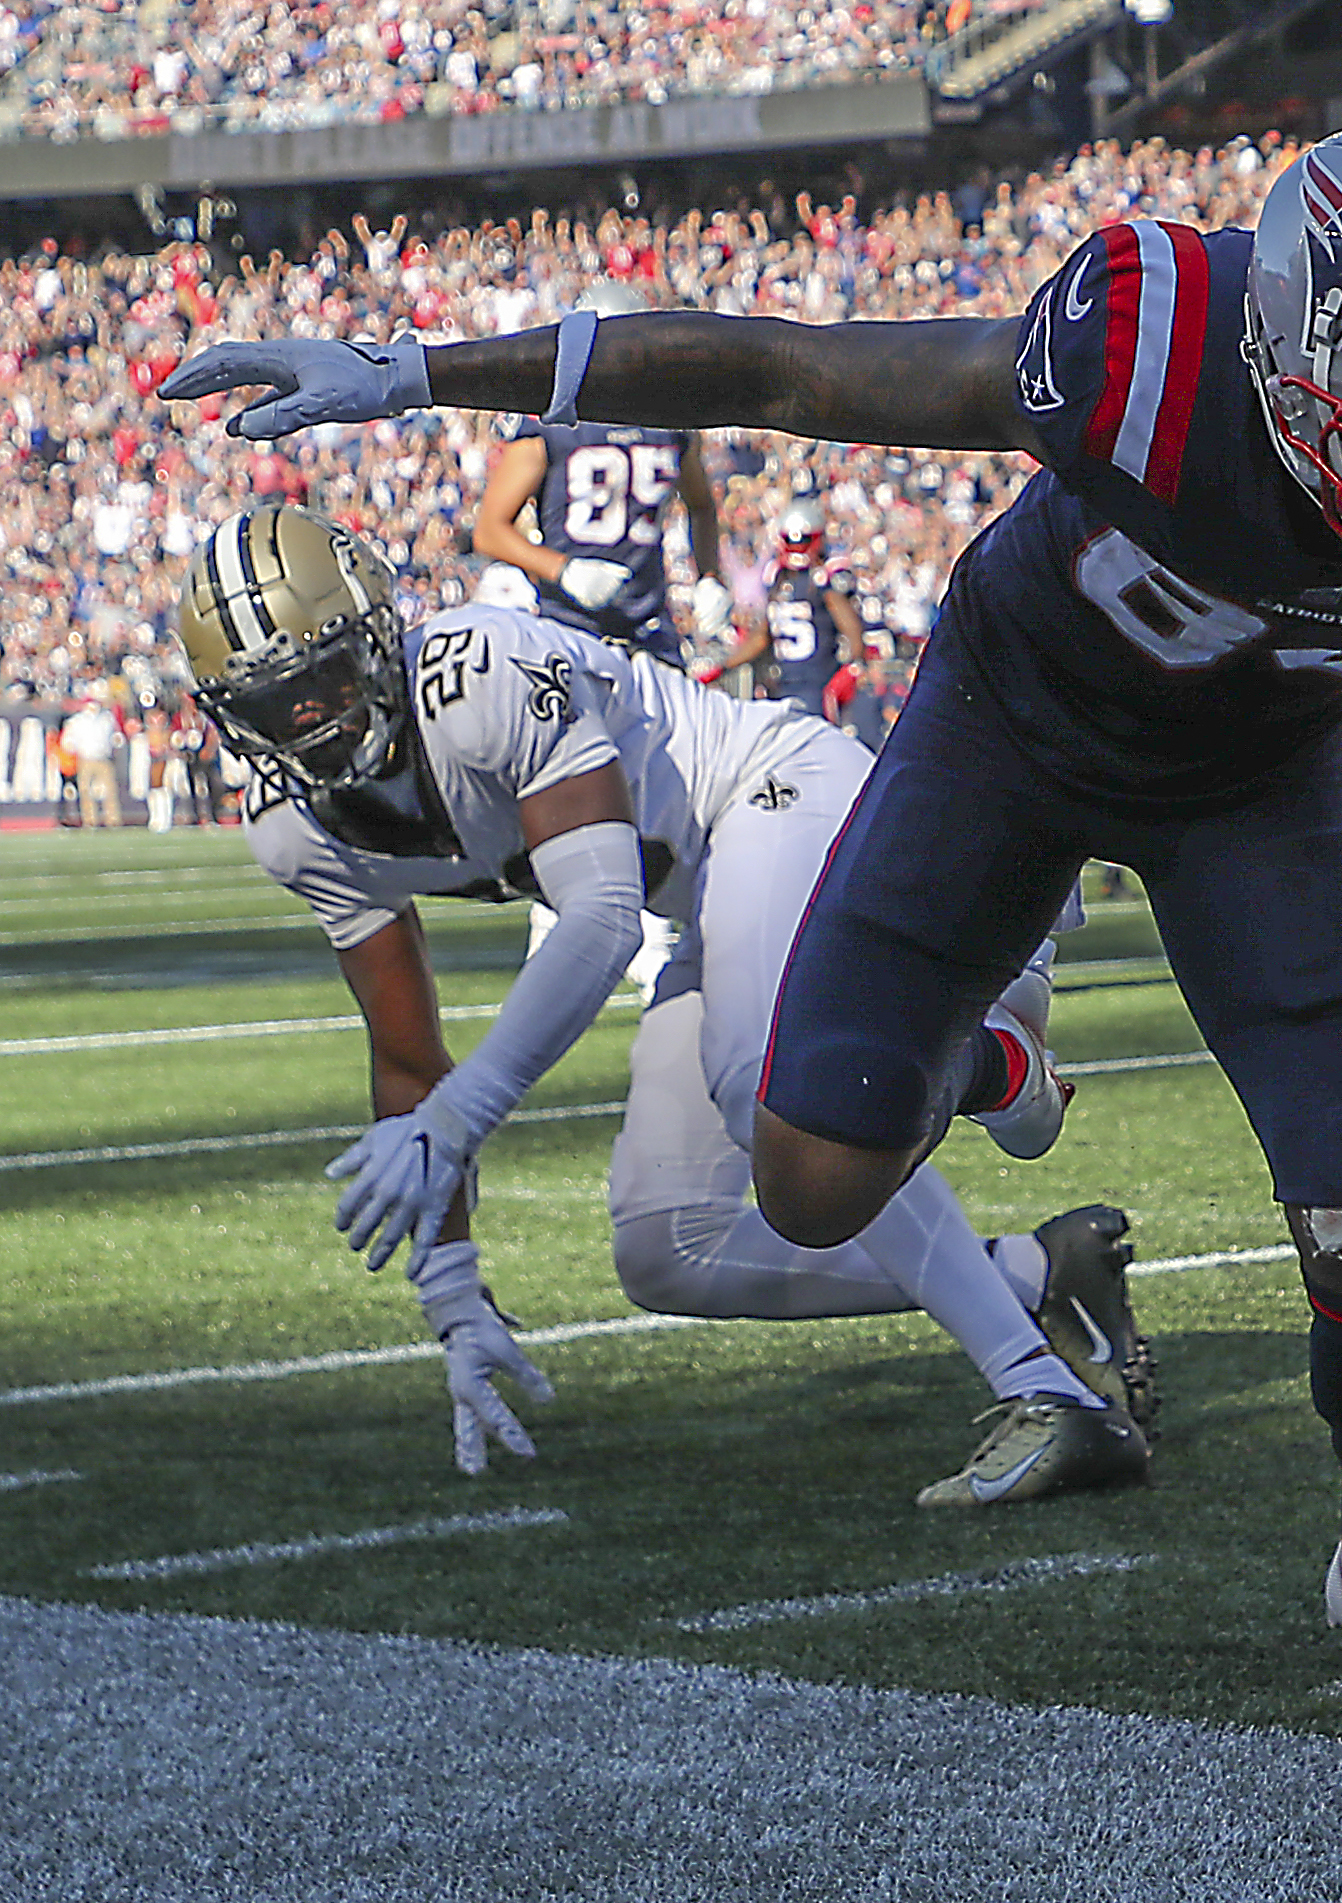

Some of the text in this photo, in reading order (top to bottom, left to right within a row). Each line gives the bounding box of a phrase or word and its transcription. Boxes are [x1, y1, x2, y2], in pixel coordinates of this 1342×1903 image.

[565, 444, 681, 546] 85
[422, 629, 474, 721] 29
[767, 601, 818, 661] 5
